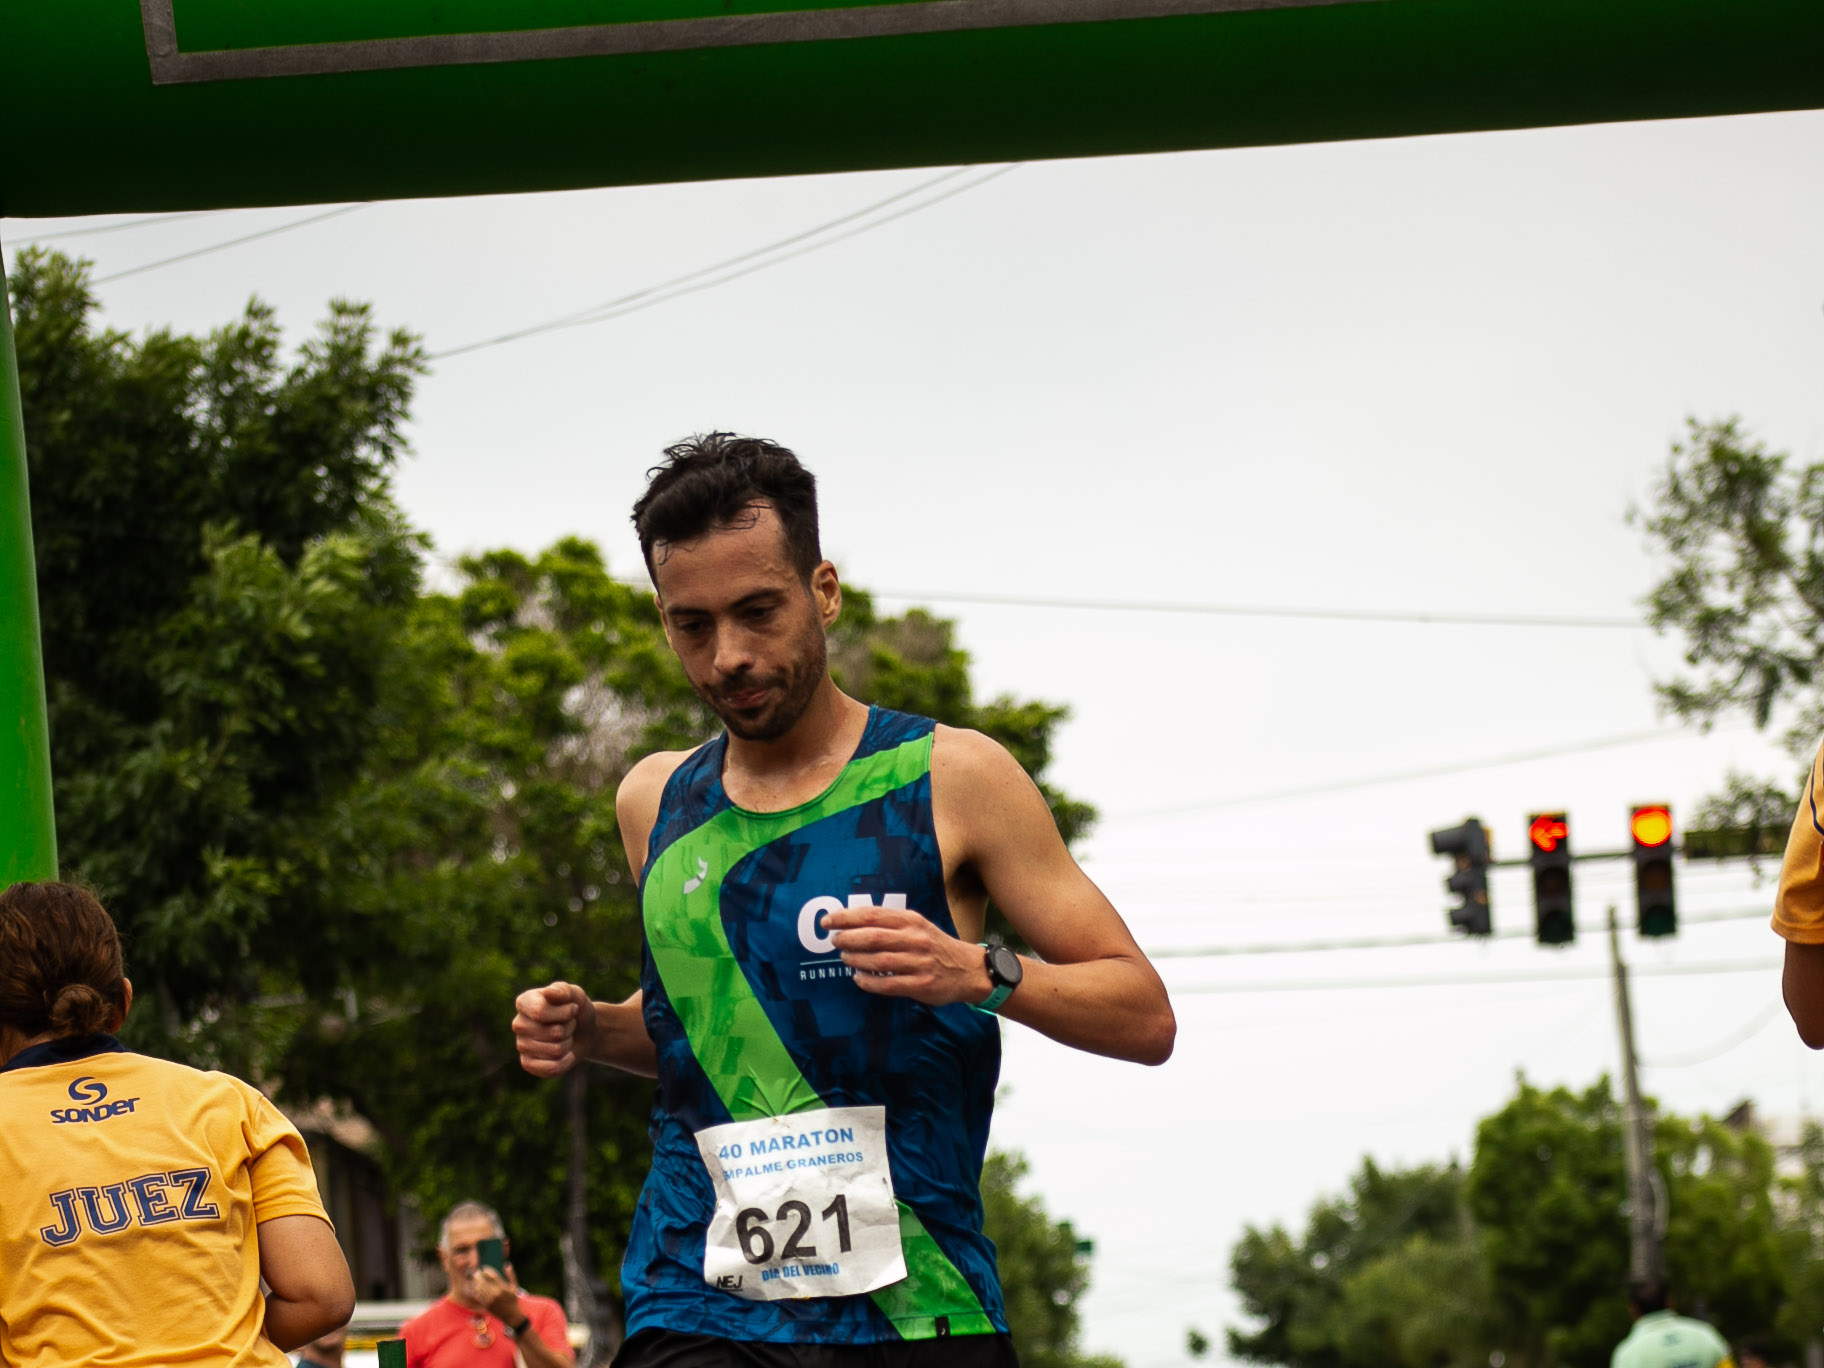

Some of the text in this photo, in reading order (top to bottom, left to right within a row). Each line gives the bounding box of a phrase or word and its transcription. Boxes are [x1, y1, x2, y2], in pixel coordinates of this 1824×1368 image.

[719, 1128, 854, 1160] 40 MARATON
[787, 1152, 864, 1170] GRANEROS
[41, 1167, 220, 1247] JUEZ
[736, 1194, 852, 1265] 621
[782, 1264, 801, 1278] DEL
